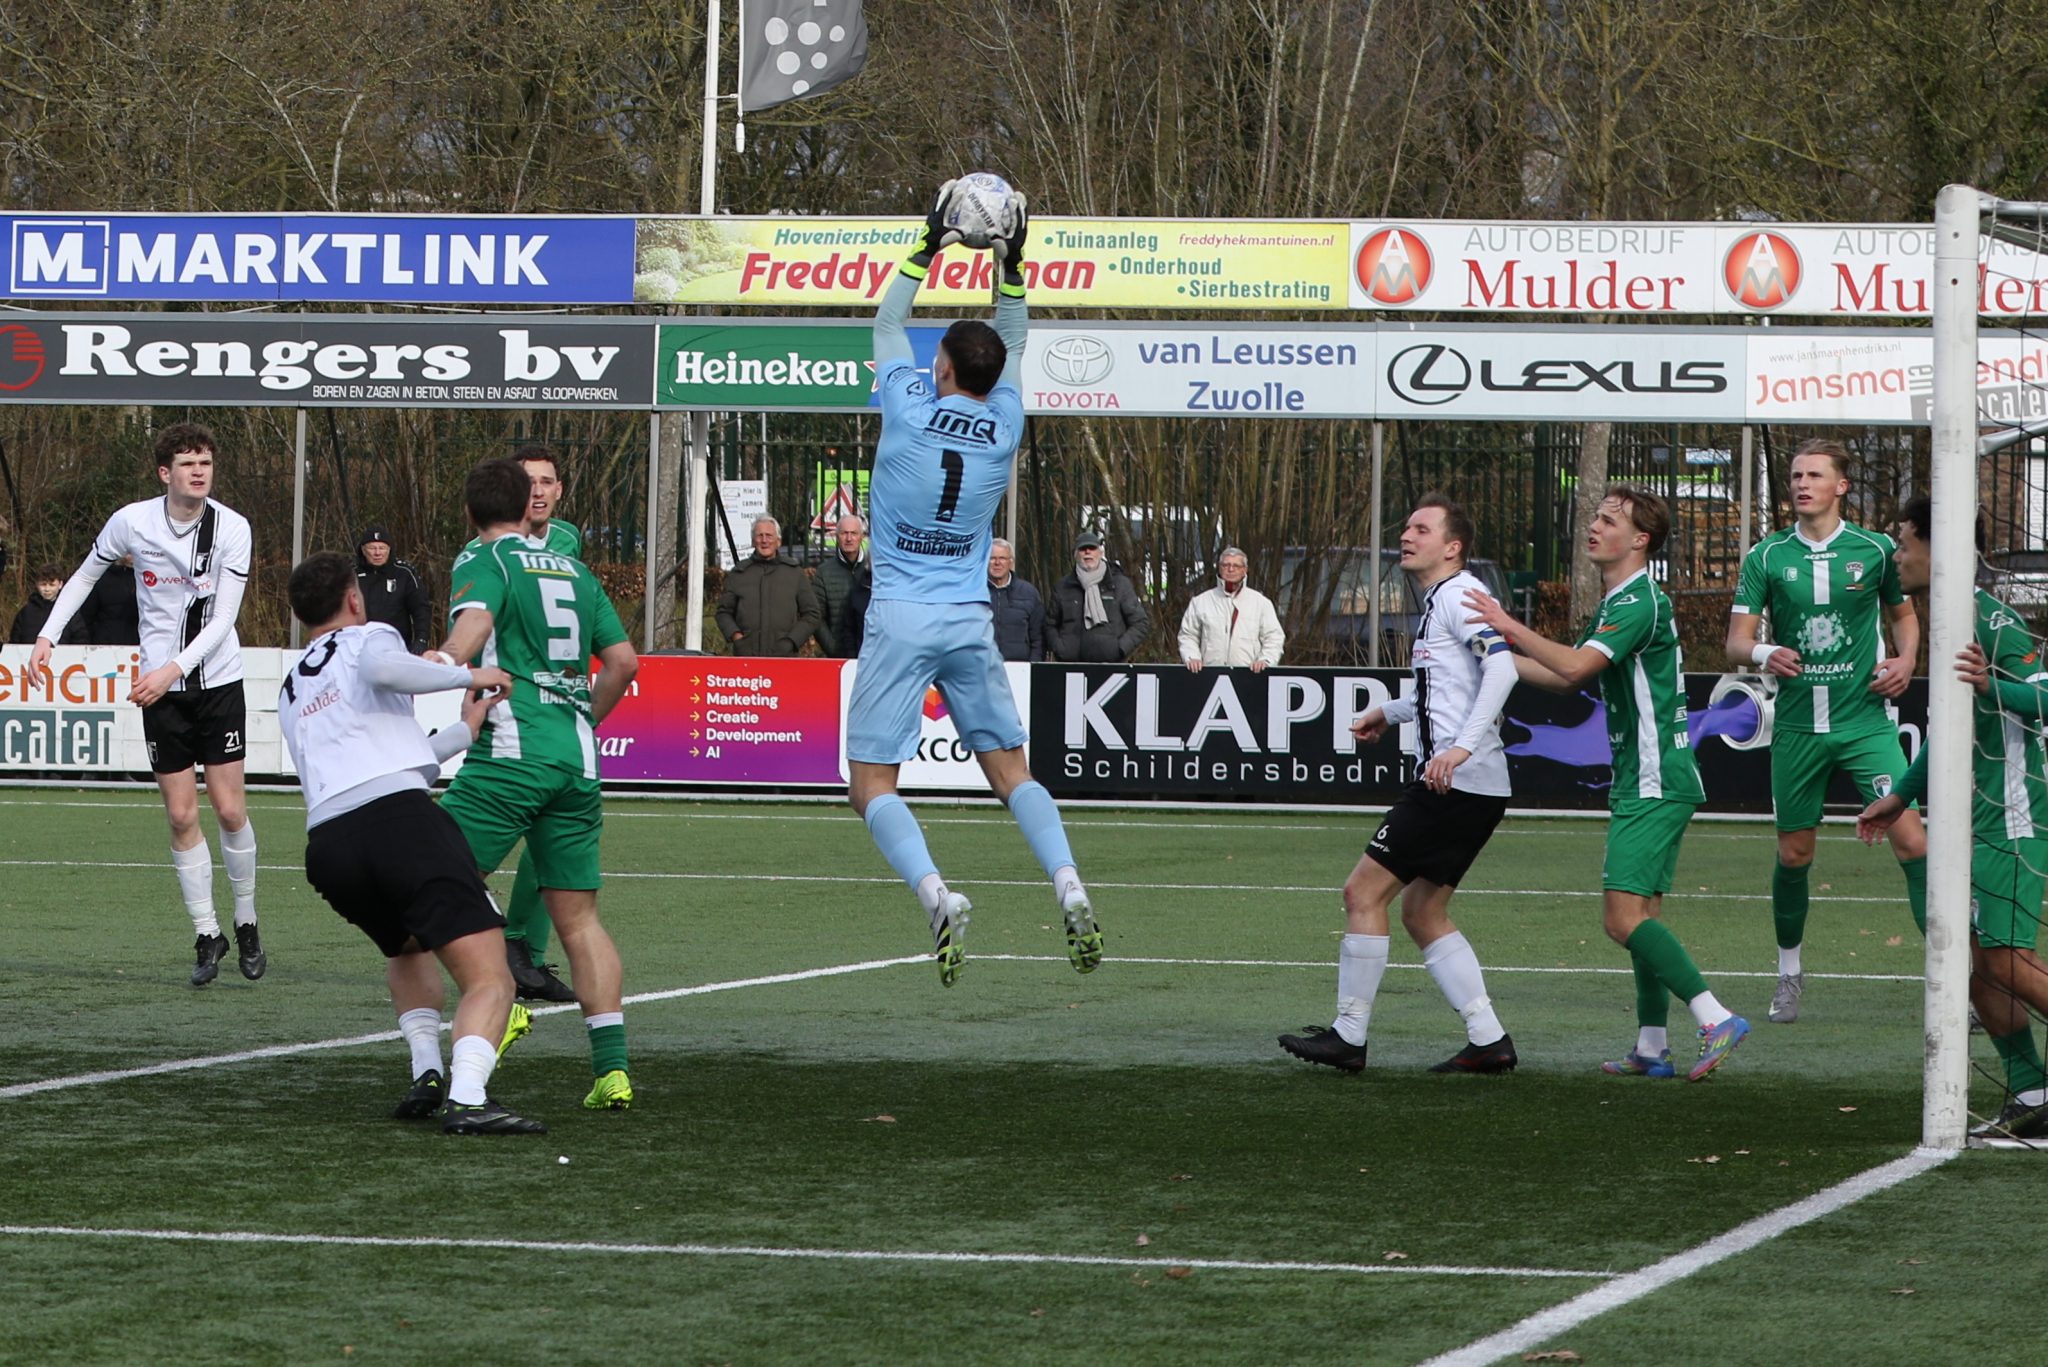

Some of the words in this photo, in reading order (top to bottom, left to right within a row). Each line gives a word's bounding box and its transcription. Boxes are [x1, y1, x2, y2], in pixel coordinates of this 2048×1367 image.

[774, 228, 923, 246] Hoveniersbedri
[1056, 231, 1158, 252] Tuinaanleg
[1179, 233, 1334, 249] freddyhekmantuinen.nl
[1464, 227, 1685, 254] AUTOBEDRIJF
[117, 232, 550, 287] MARKTLINK
[1120, 257, 1222, 276] Onderhoud
[739, 253, 895, 299] Freddy
[1461, 259, 1685, 311] Mulder
[1189, 280, 1331, 302] Sierbestrating
[59, 324, 471, 391] Rengers
[499, 329, 621, 382] bv
[1138, 341, 1200, 365] van
[1211, 336, 1357, 366] Leussen
[1769, 341, 1902, 363] www.jansmaenhendriks.nl
[675, 351, 860, 386] Heineken
[1480, 360, 1728, 393] LEXUS
[312, 384, 347, 398] BOREN
[350, 385, 364, 398] EN
[366, 385, 400, 399] ZAGEN
[402, 385, 413, 399] IN
[453, 386, 485, 400] STEEN
[487, 386, 501, 400] EN
[504, 387, 537, 400] ASFALT
[1187, 381, 1305, 411] Zwolle
[1756, 368, 1906, 406] Jansma
[1034, 392, 1120, 408] TOYOTA
[935, 448, 965, 523] 1
[537, 577, 580, 661] 5
[706, 674, 772, 691] Strategie
[706, 691, 779, 710] Marketing
[706, 709, 760, 725] Creatie
[1064, 671, 1416, 754] KLAPP
[225, 730, 240, 748] 21
[705, 727, 802, 745] Development
[705, 745, 721, 759] AI
[1376, 824, 1390, 840] 6
